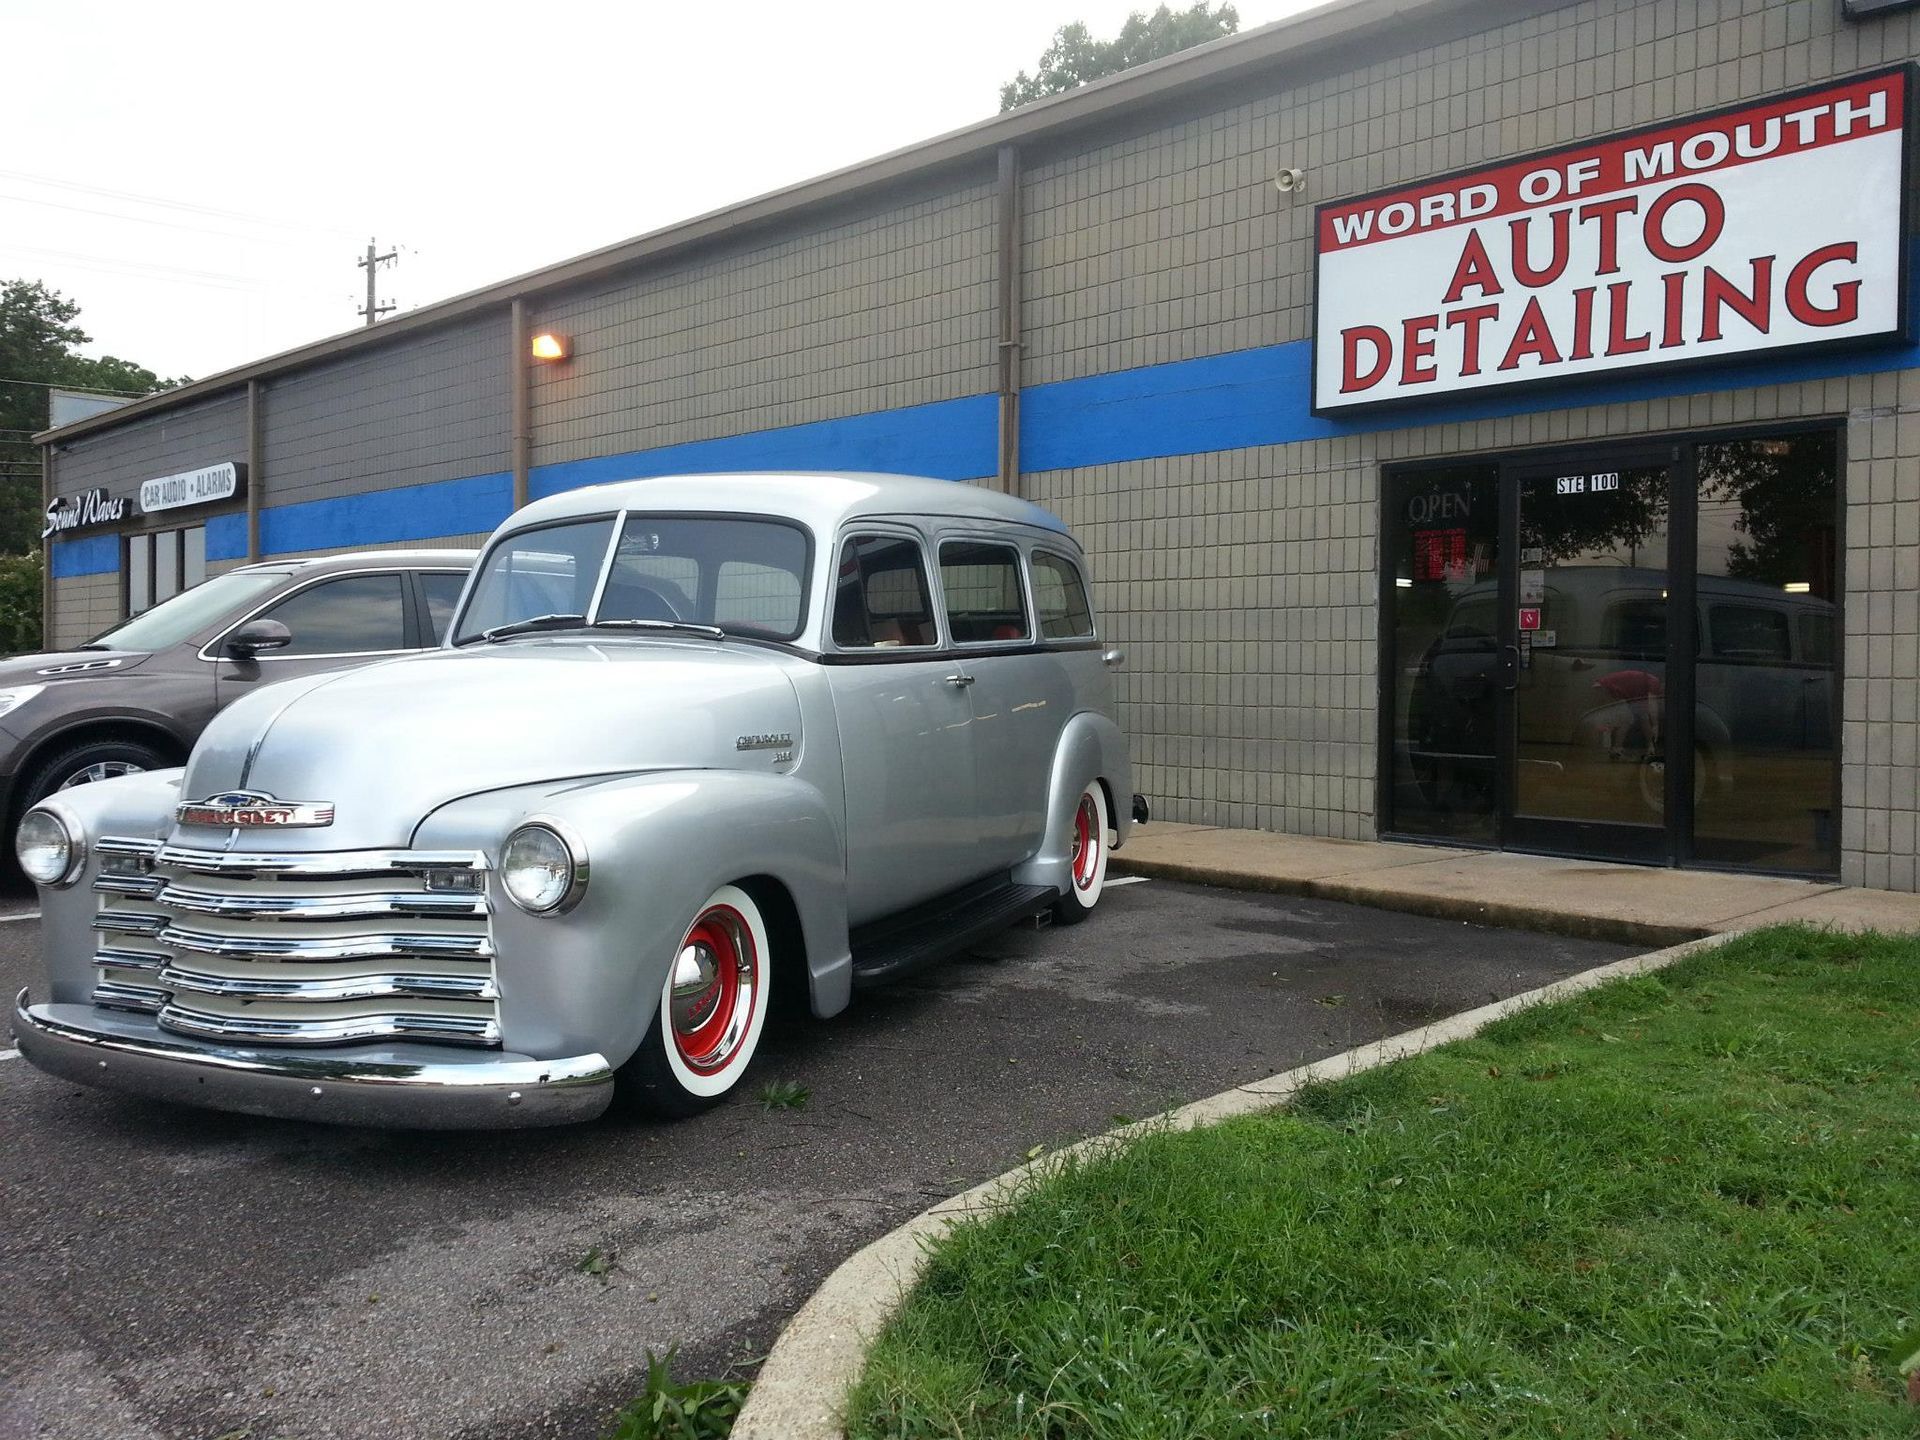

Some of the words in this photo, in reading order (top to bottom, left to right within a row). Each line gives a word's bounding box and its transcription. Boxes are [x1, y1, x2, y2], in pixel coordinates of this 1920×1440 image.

[1332, 182, 1499, 245] WORD
[1519, 157, 1601, 204] OF
[1623, 90, 1888, 184] MOUTH
[1442, 182, 1726, 304] AUTO
[1339, 240, 1863, 394] DETAILING
[144, 484, 161, 508] CAR
[161, 478, 187, 504] AUDIO
[195, 467, 232, 498] ALARMS
[1408, 491, 1470, 521] OPEN
[1558, 476, 1583, 494] STE
[1593, 473, 1618, 490] 100
[41, 496, 81, 539] Sound
[82, 488, 124, 526] Waves
